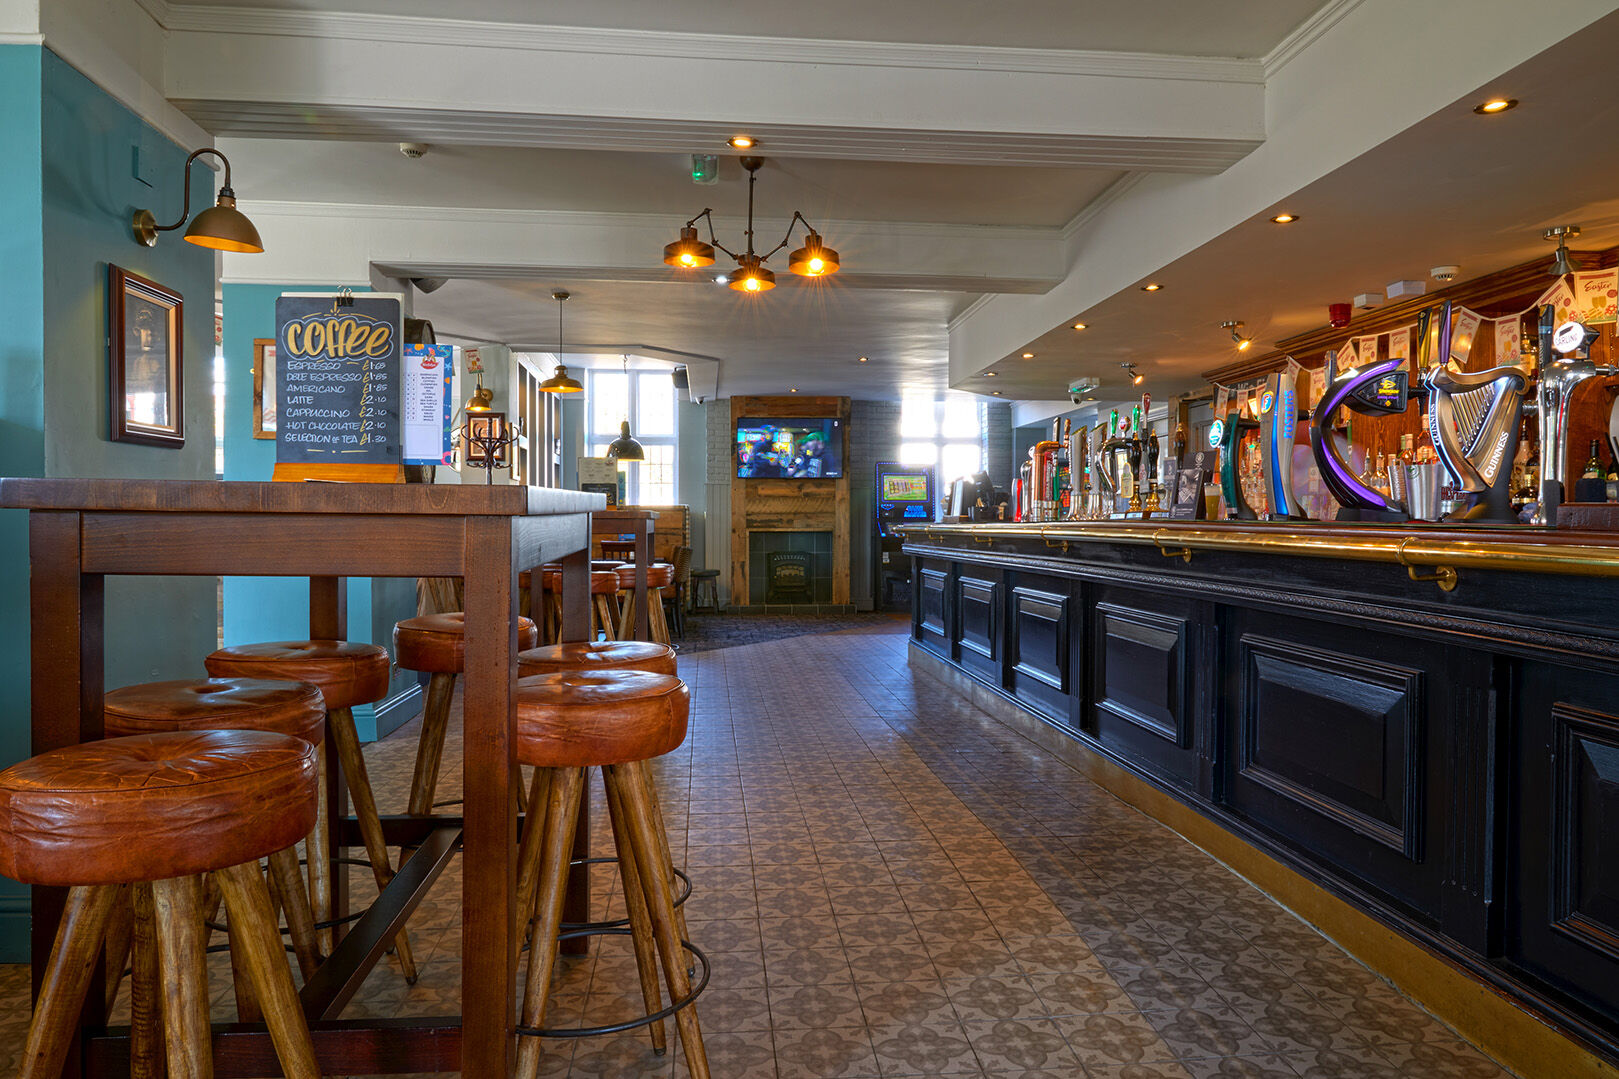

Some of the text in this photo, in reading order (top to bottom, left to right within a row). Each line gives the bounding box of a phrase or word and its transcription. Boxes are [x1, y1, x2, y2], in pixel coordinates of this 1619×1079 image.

[1584, 281, 1612, 292] Easter
[287, 361, 341, 371] ESPRESSO
[286, 372, 308, 381] DBLE
[310, 372, 362, 382] ESPRESSO
[286, 384, 346, 393] AMERICANO
[287, 396, 314, 405] LATTE
[286, 408, 350, 418] CAPPUCCINO
[1283, 390, 1294, 439] FOSTER'S
[285, 421, 308, 430] HOT
[308, 422, 360, 430] CHOCOLATE
[1430, 403, 1440, 447] GUINNESS
[285, 433, 331, 442] SELECTION
[342, 434, 358, 443] TEA
[1484, 431, 1509, 478] GUINNESS
